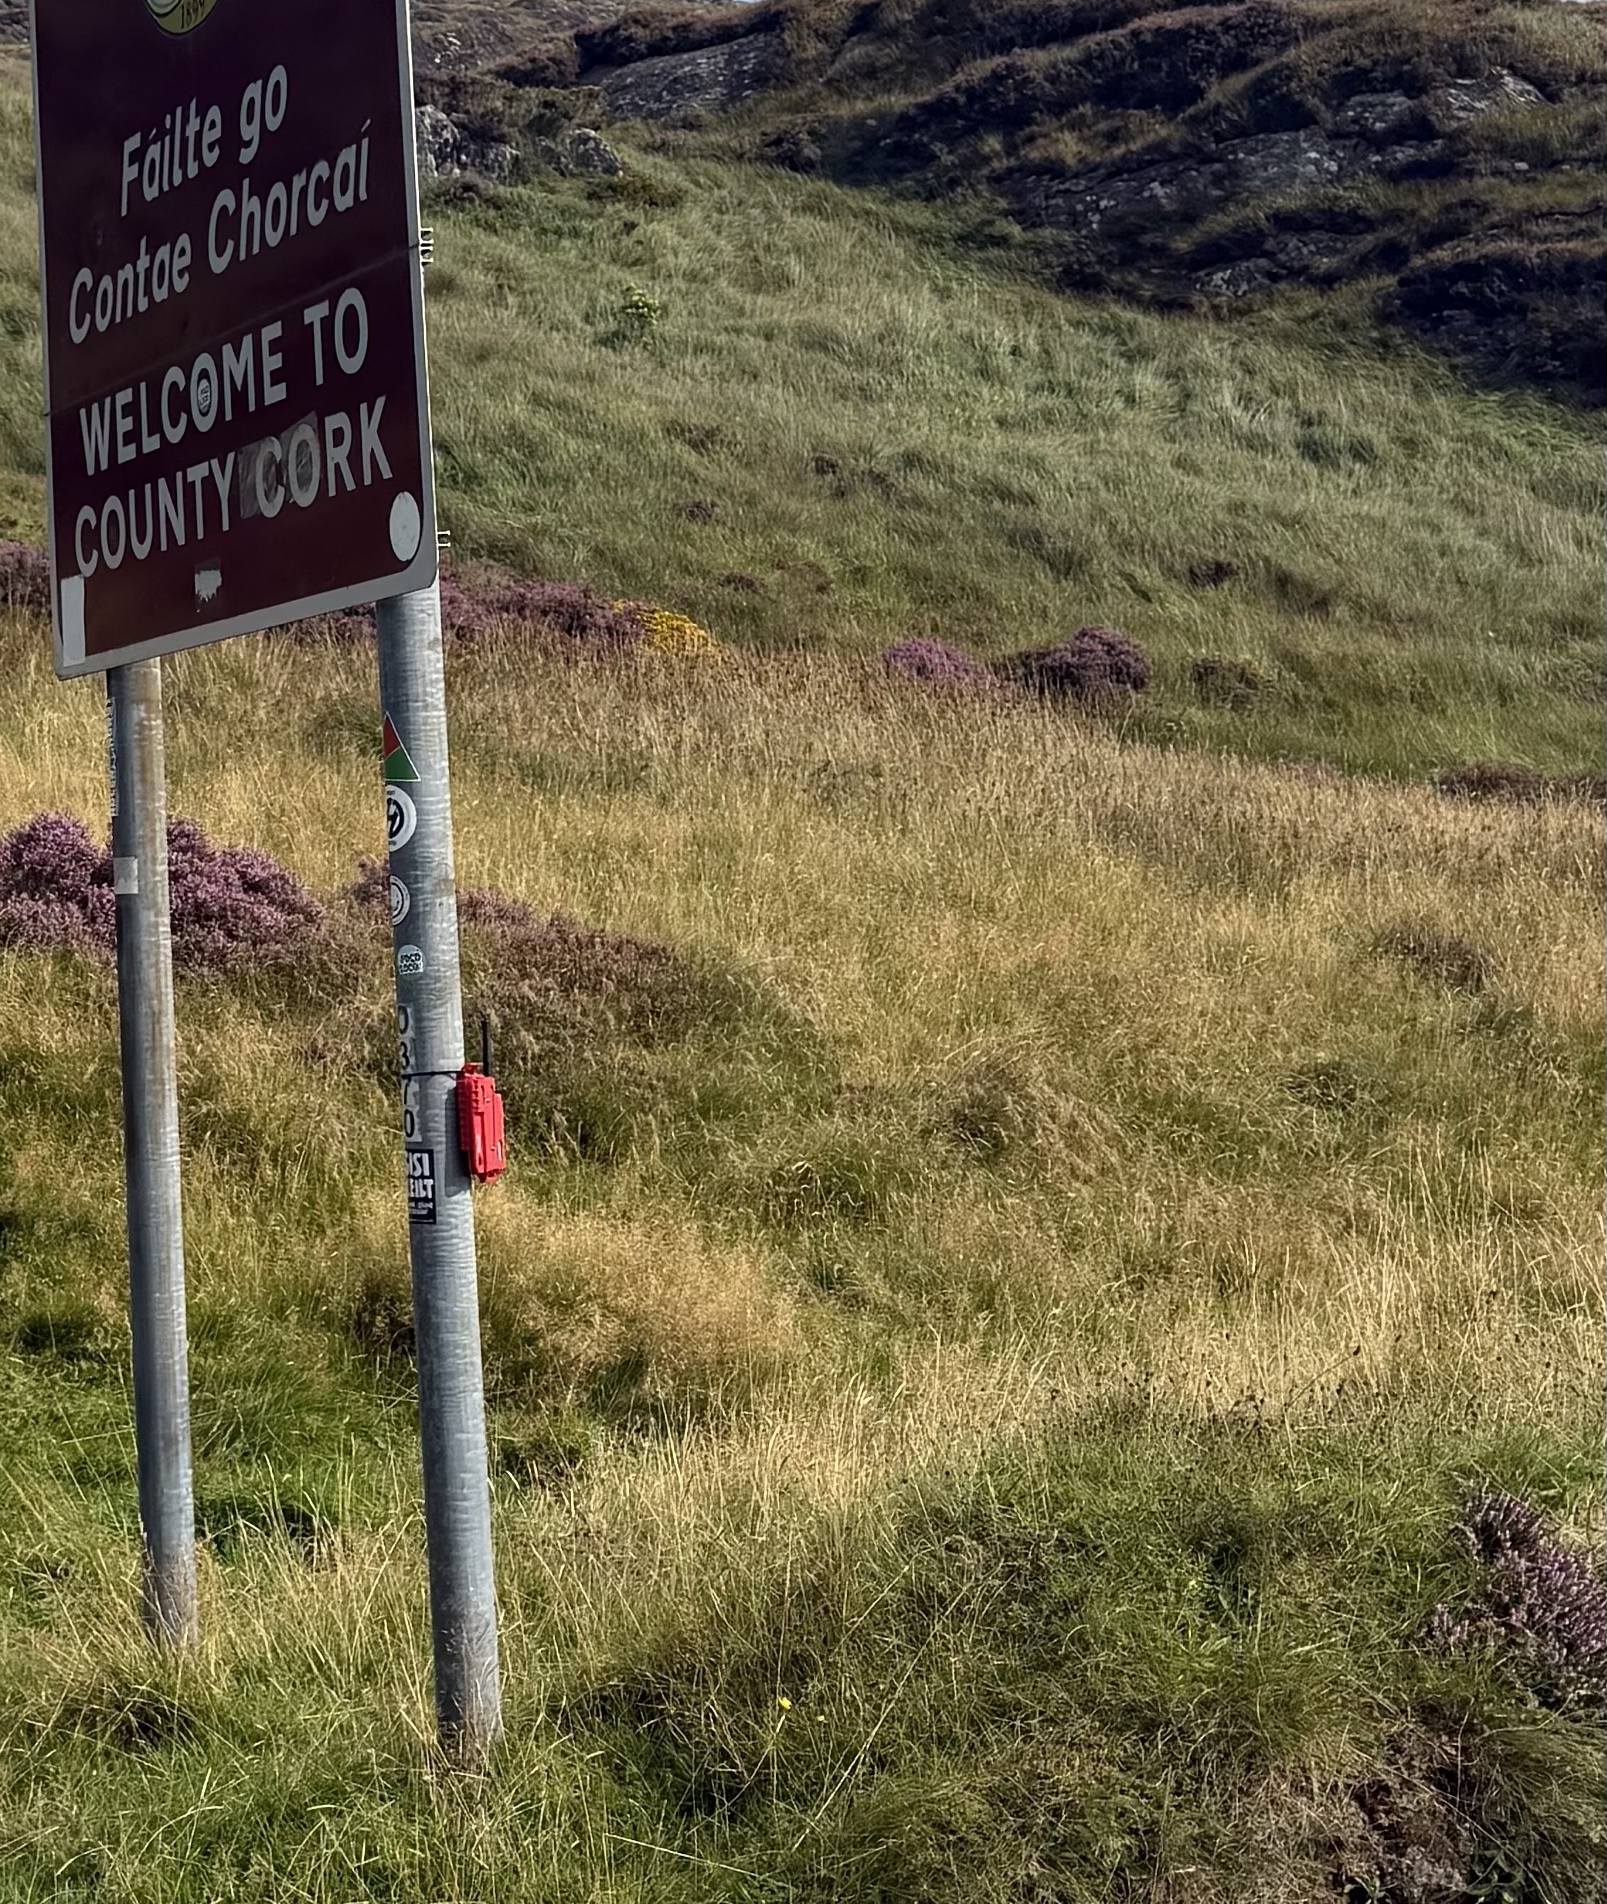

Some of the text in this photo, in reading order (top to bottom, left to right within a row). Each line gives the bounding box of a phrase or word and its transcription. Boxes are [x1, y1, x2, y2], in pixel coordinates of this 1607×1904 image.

[69, 118, 373, 345] Contae Chorcaí
[119, 64, 288, 217] Fáilte go
[79, 287, 369, 476] WELCOME TO
[74, 395, 393, 578] COUNTY CORK
